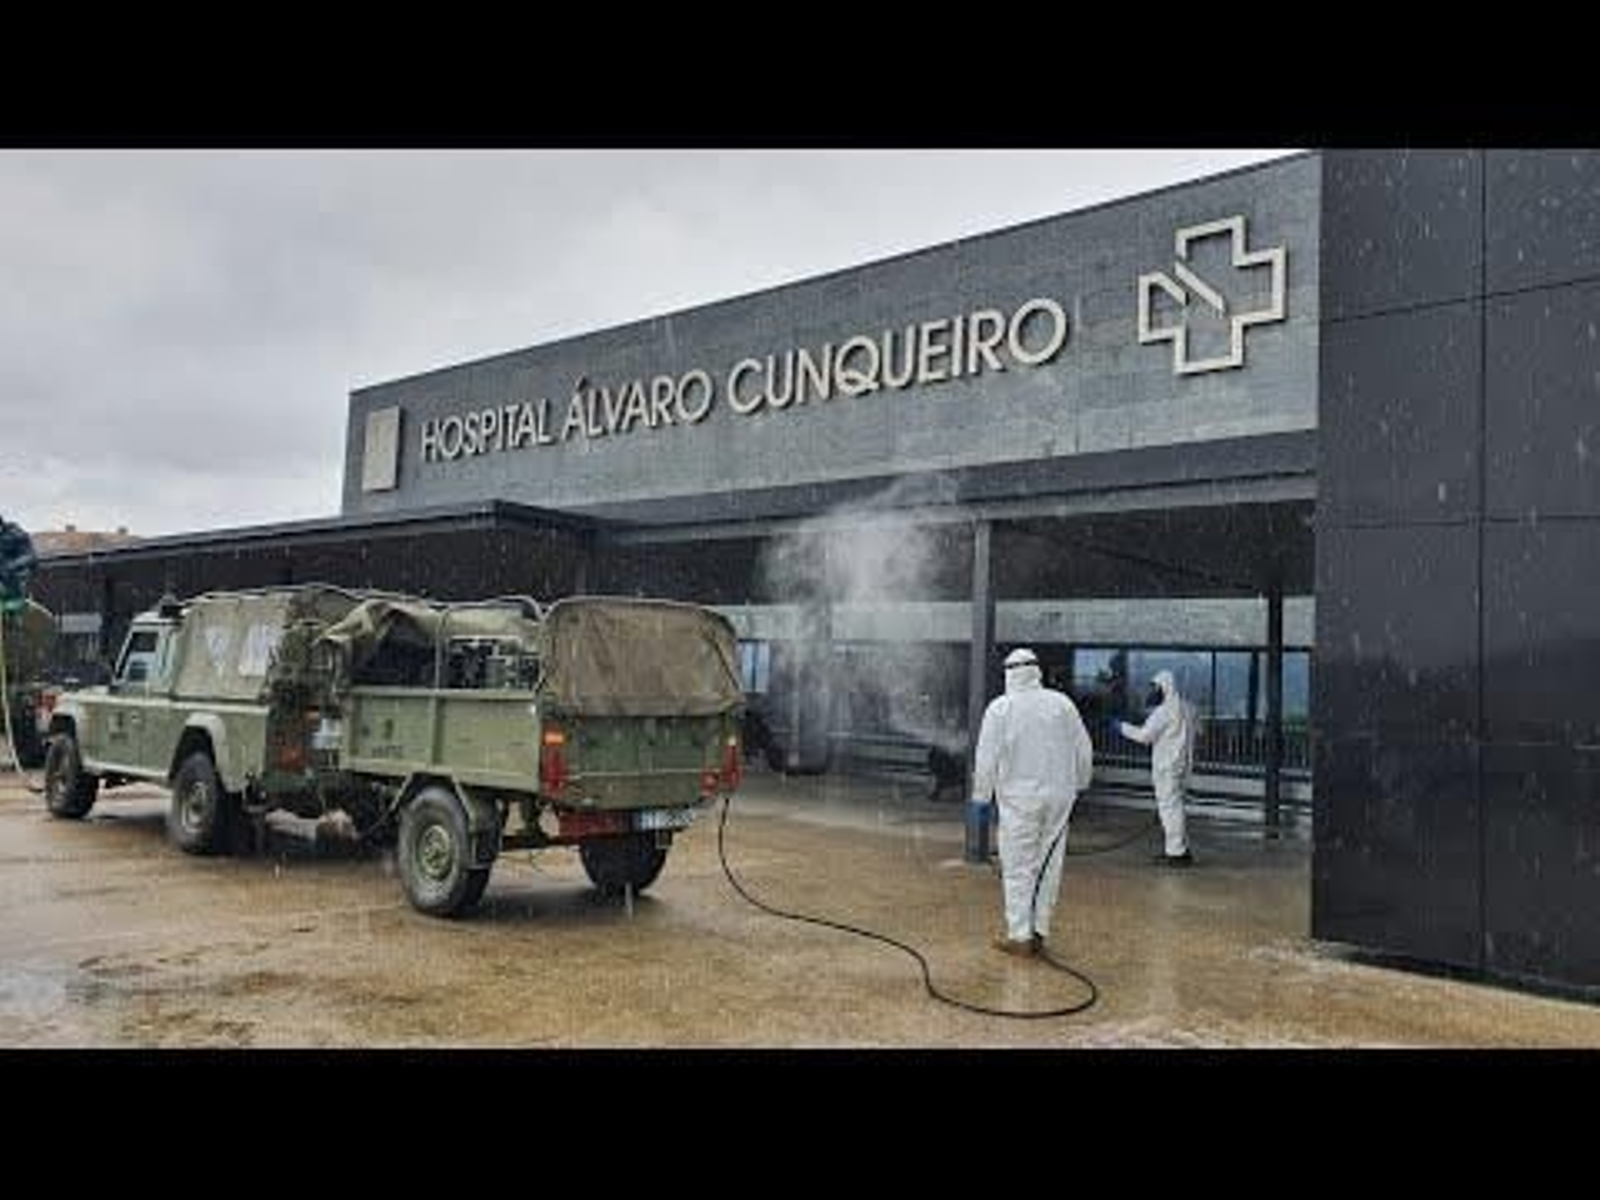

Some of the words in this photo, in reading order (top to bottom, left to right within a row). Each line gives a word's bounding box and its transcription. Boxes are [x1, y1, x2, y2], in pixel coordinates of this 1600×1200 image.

[421, 399, 553, 462] HOSPITAL
[562, 370, 713, 441] ÁLVARO
[727, 299, 1068, 413] CUNQUEIRO
